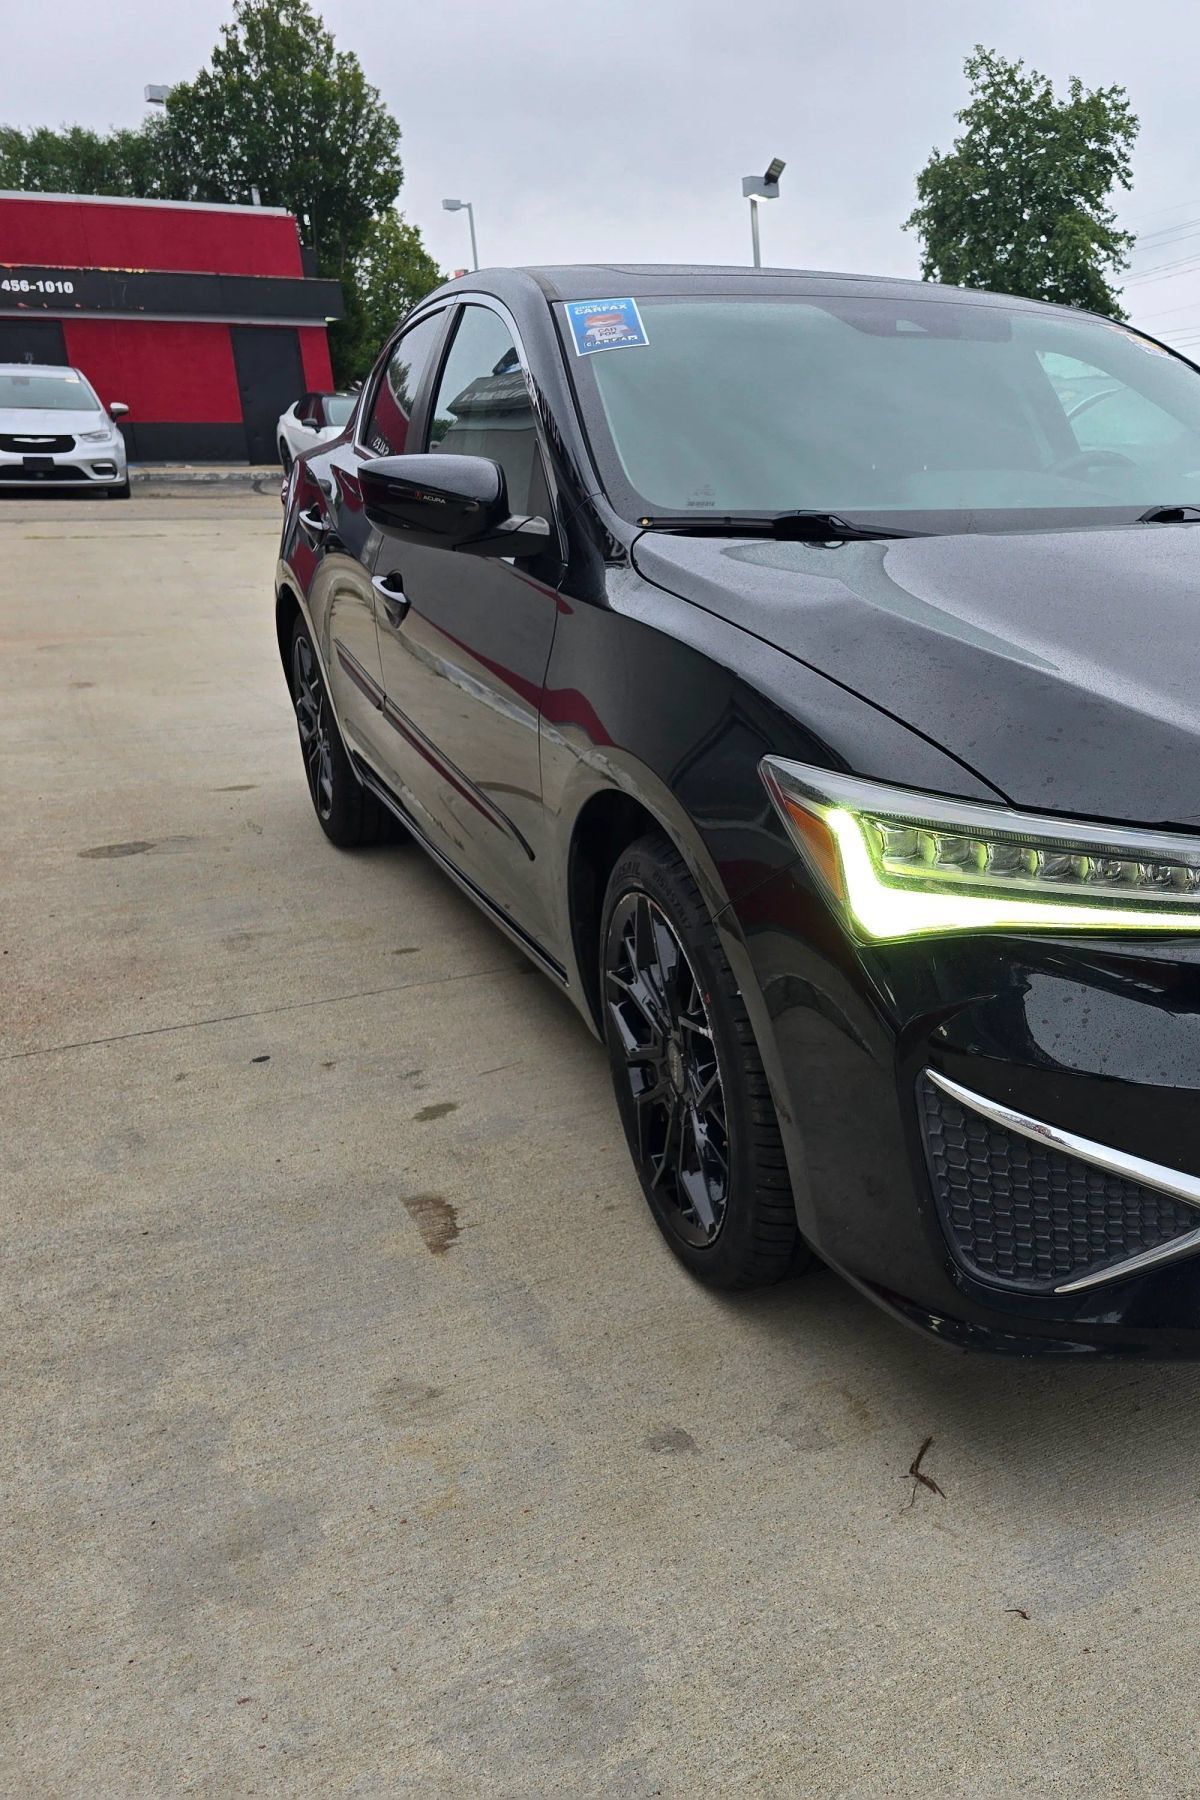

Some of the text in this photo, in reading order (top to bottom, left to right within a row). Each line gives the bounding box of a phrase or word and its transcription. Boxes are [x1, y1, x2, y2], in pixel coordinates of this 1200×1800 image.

[1, 279, 74, 294] 456-1010
[574, 303, 627, 315] CARFAX
[423, 495, 446, 504] ACURA
